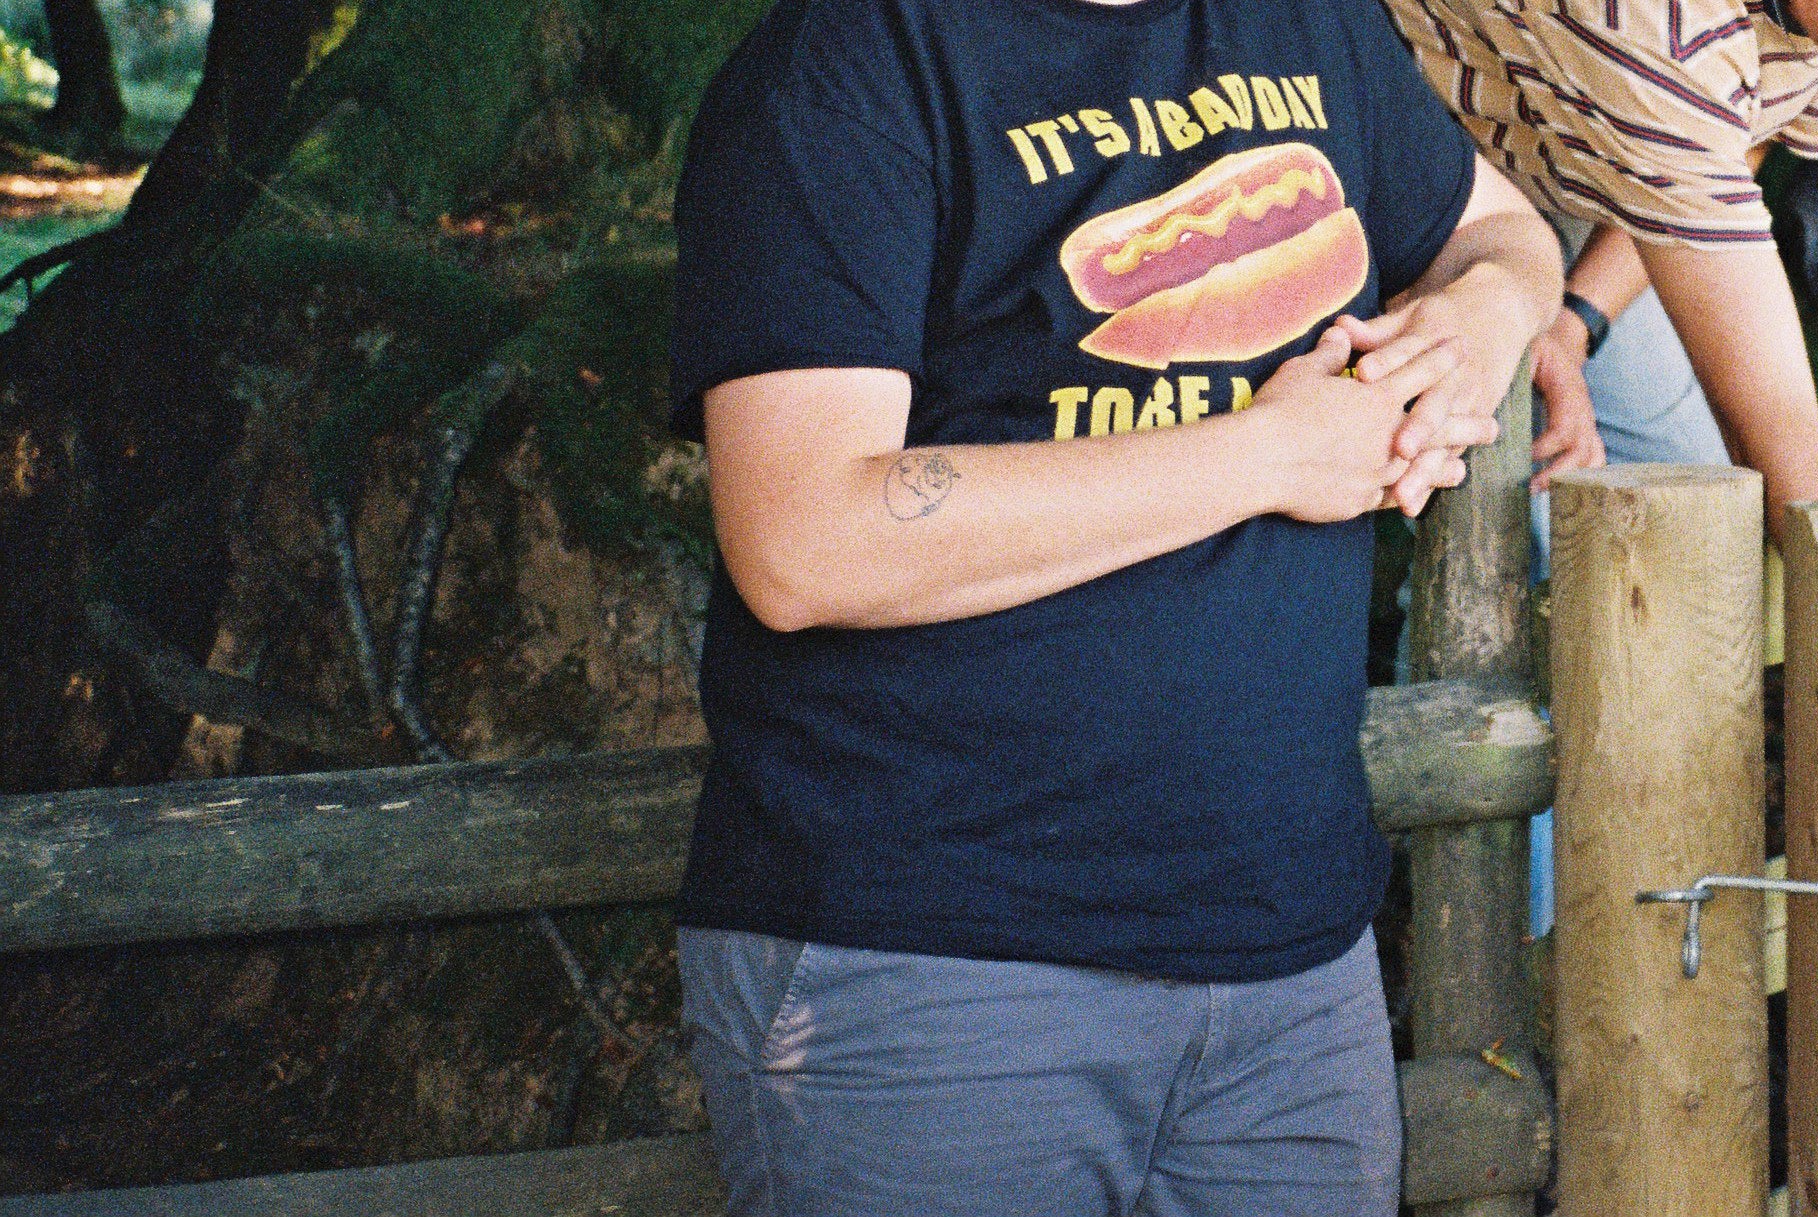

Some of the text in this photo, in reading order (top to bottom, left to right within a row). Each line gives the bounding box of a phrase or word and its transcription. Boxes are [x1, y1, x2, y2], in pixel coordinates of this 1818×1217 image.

[1006, 108, 1131, 185] IT'S
[1154, 73, 1254, 152] BAD
[1250, 74, 1329, 131] DAY
[1049, 386, 1135, 442] TO
